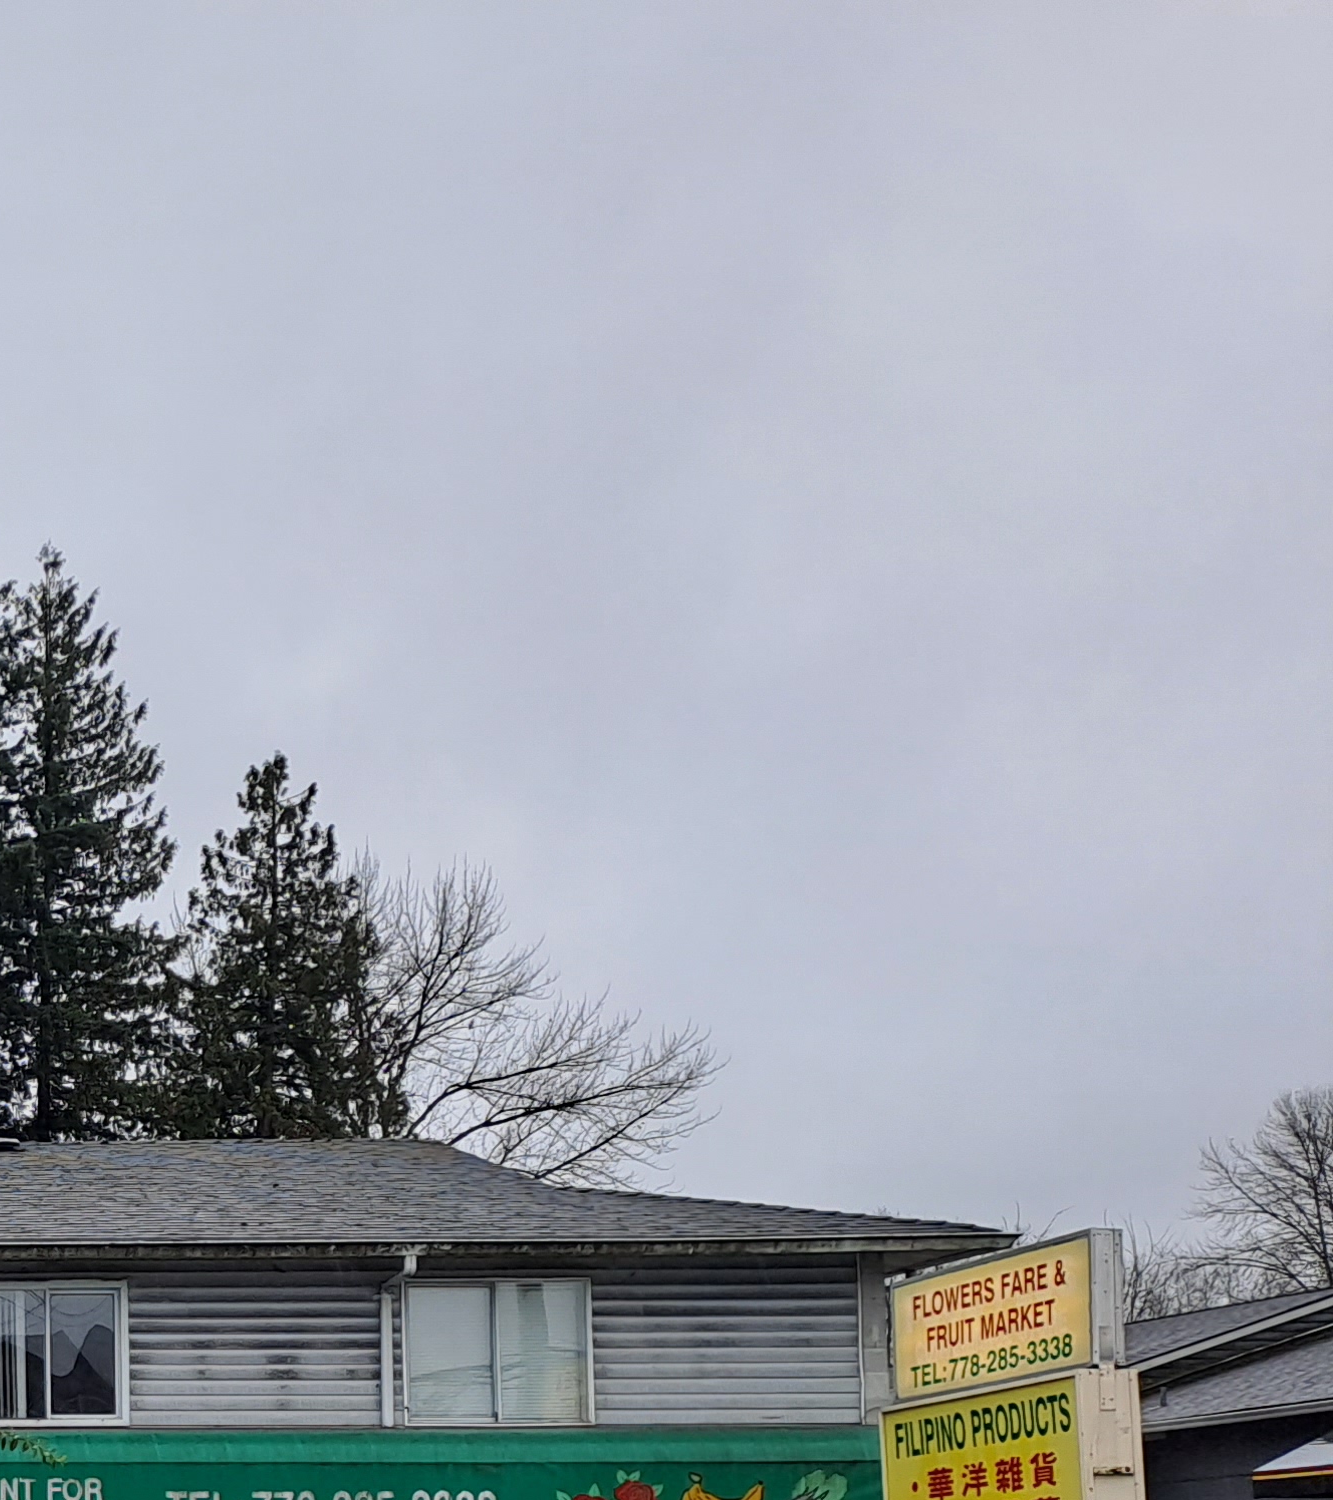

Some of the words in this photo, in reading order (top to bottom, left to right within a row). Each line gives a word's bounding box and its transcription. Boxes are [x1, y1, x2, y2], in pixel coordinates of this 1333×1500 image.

[912, 1277, 995, 1321] FLOWERS
[1001, 1263, 1049, 1299] FARE
[1054, 1259, 1066, 1287] &
[926, 1317, 975, 1352] FRUIT
[980, 1298, 1055, 1340] MARKET
[894, 1412, 966, 1459] FILIPINO
[970, 1392, 1072, 1447] PRODUCTS
